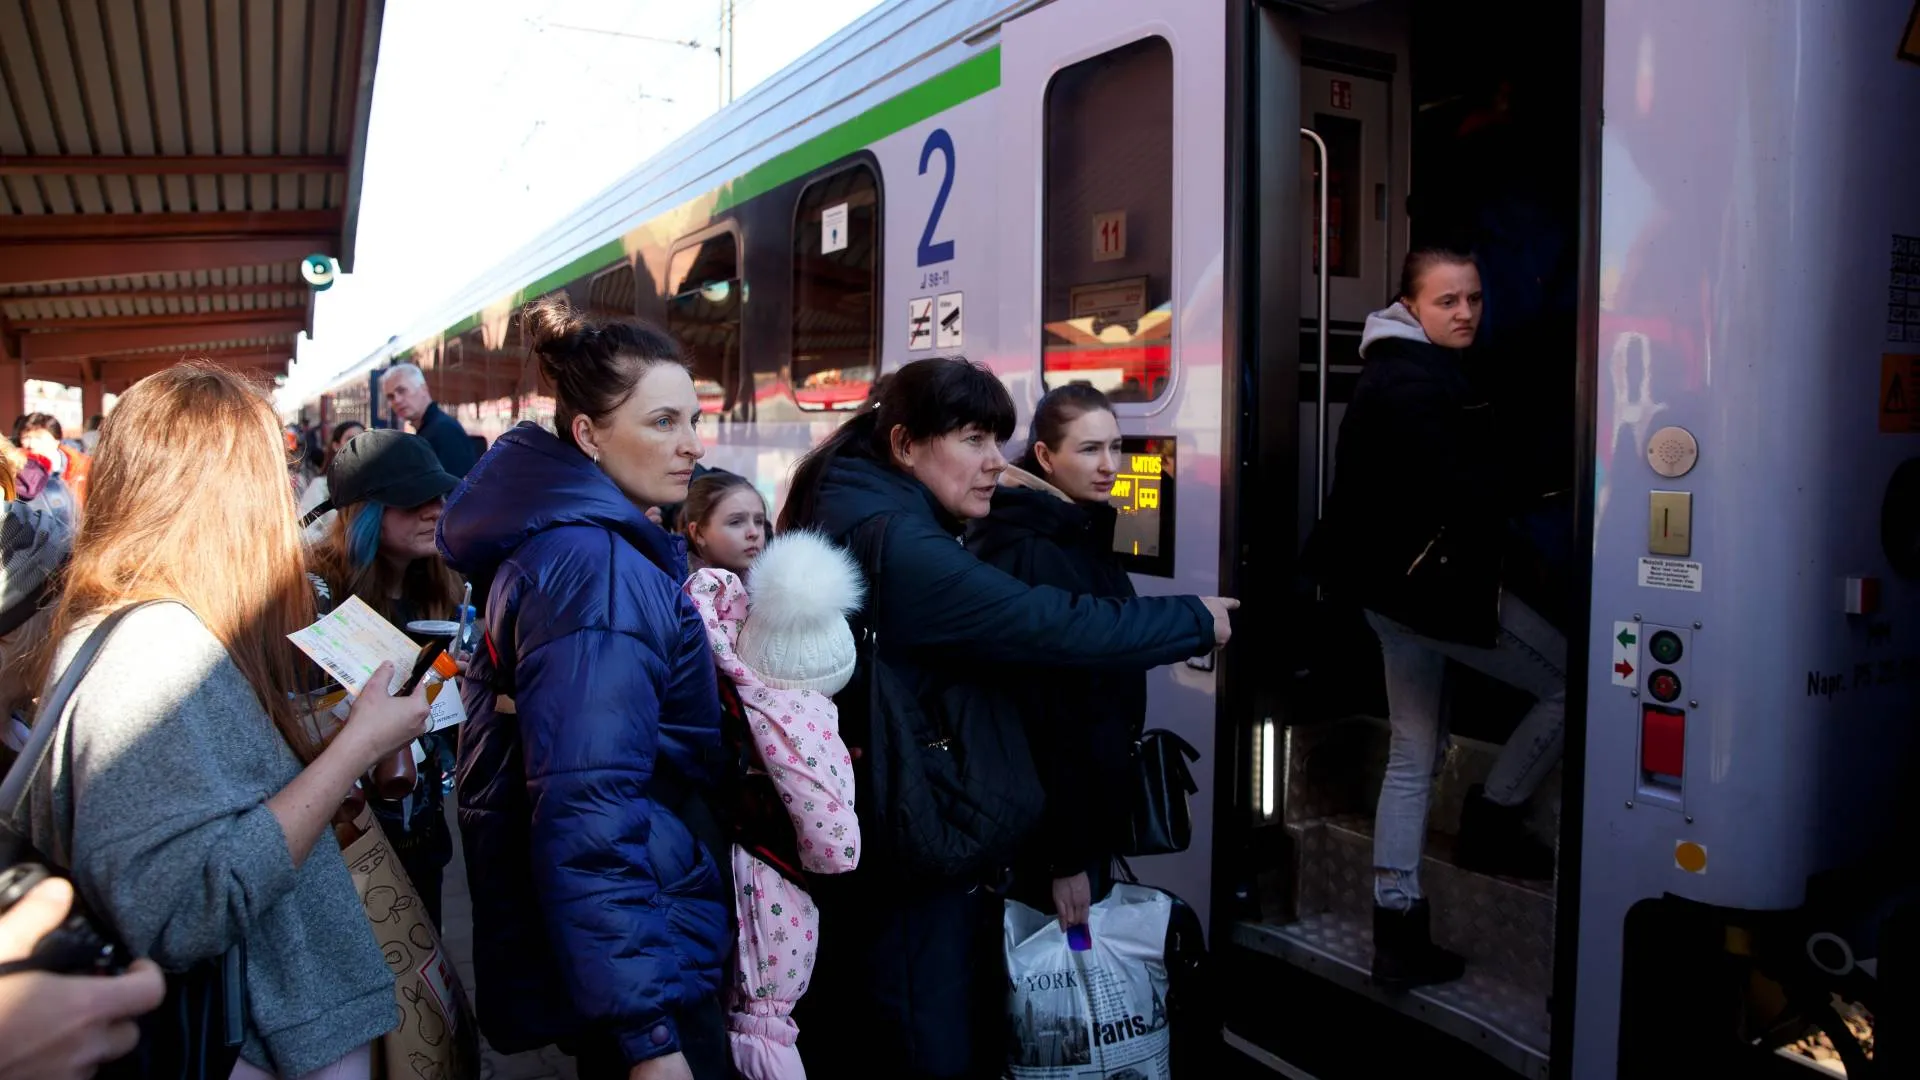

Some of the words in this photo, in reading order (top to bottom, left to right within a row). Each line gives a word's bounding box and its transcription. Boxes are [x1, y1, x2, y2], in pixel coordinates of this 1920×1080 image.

[917, 128, 955, 268] 2
[1102, 220, 1119, 252] 11
[1807, 671, 1846, 702] Napr.
[1027, 970, 1077, 992] YORK
